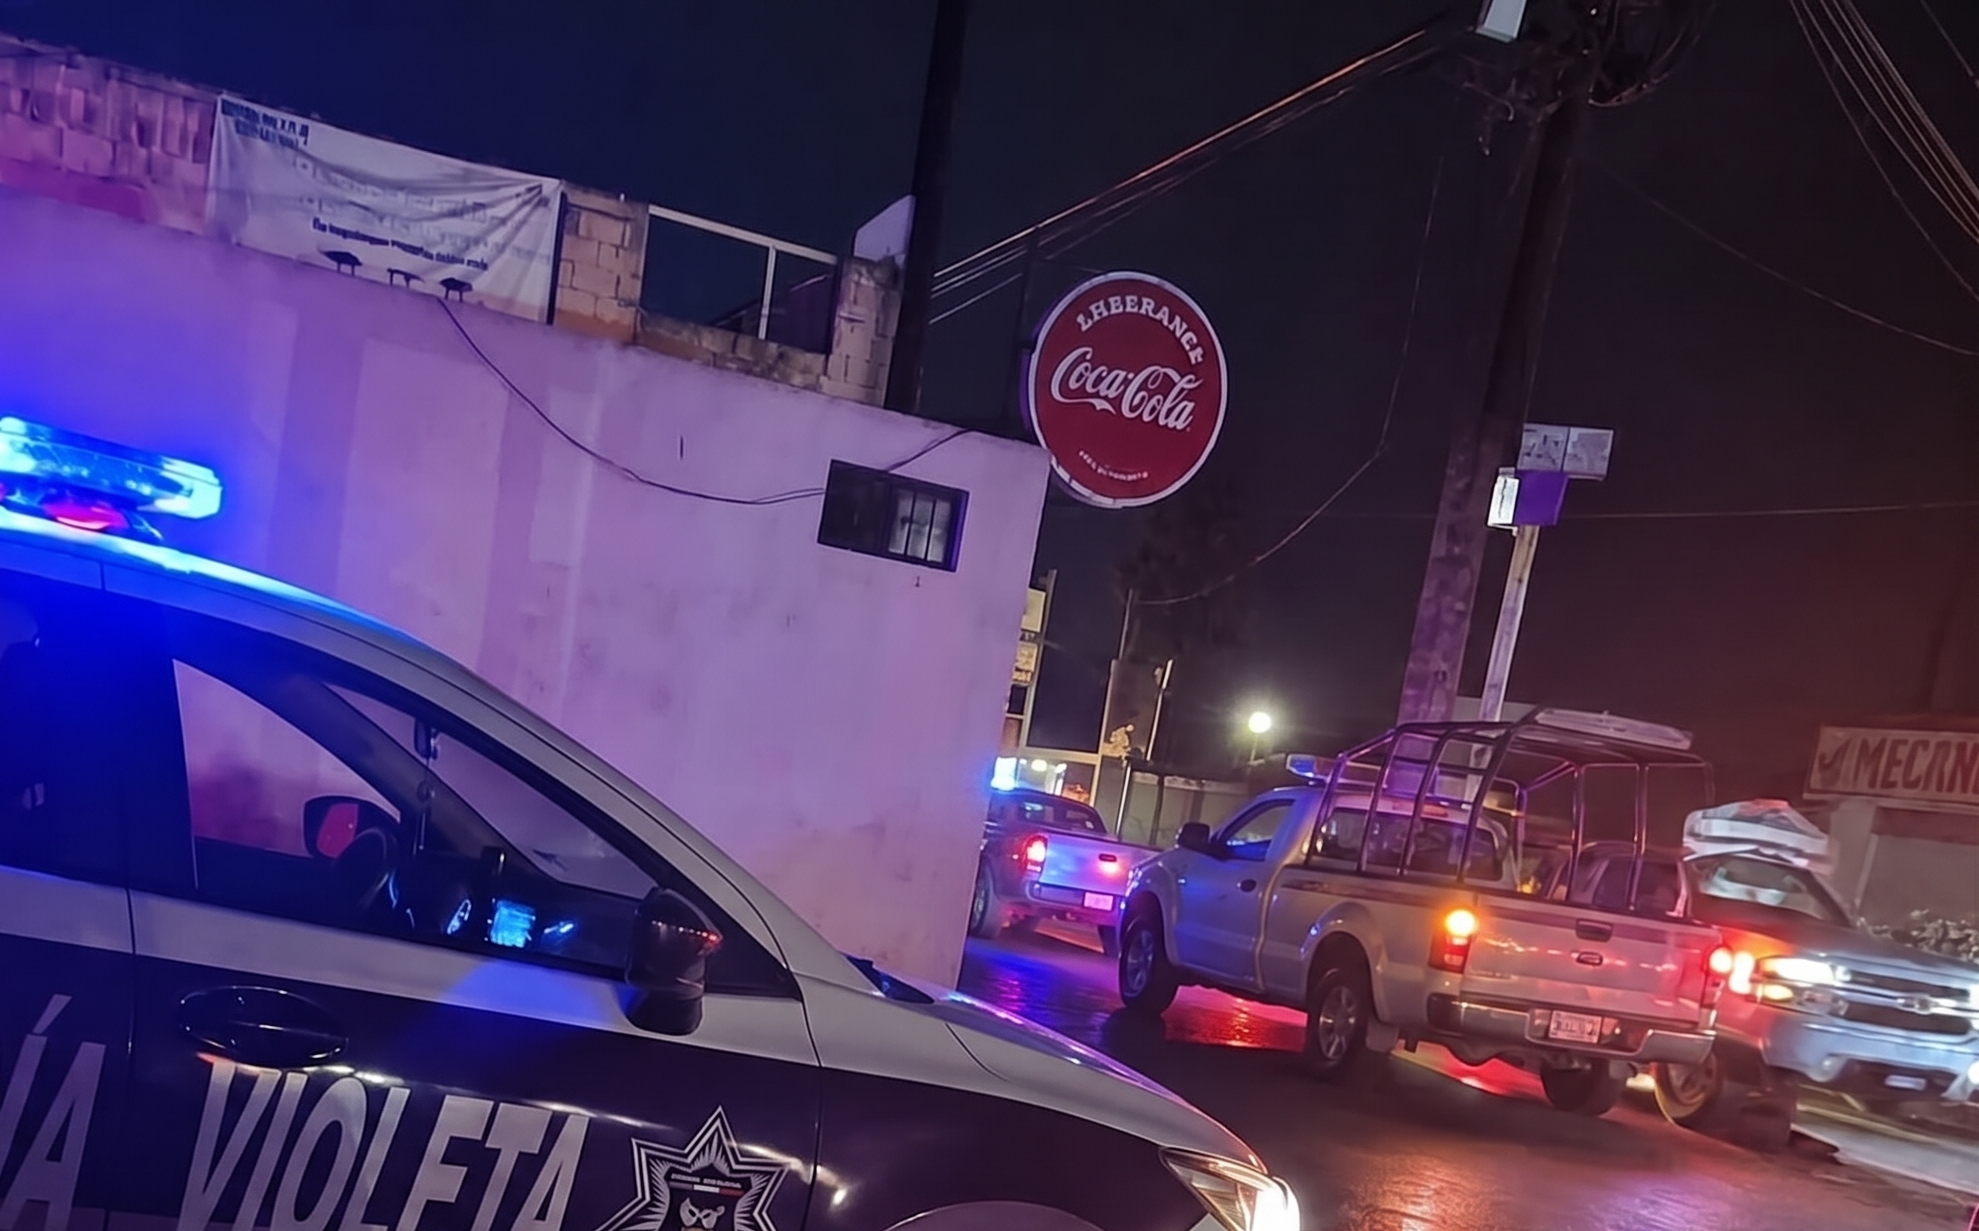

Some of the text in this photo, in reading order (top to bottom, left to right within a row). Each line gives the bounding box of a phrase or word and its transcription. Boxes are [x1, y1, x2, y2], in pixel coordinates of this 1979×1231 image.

[1051, 346, 1203, 430] Coca-Cola
[1854, 737, 1979, 794] MECAN
[178, 1059, 590, 1231] VIOLETA
